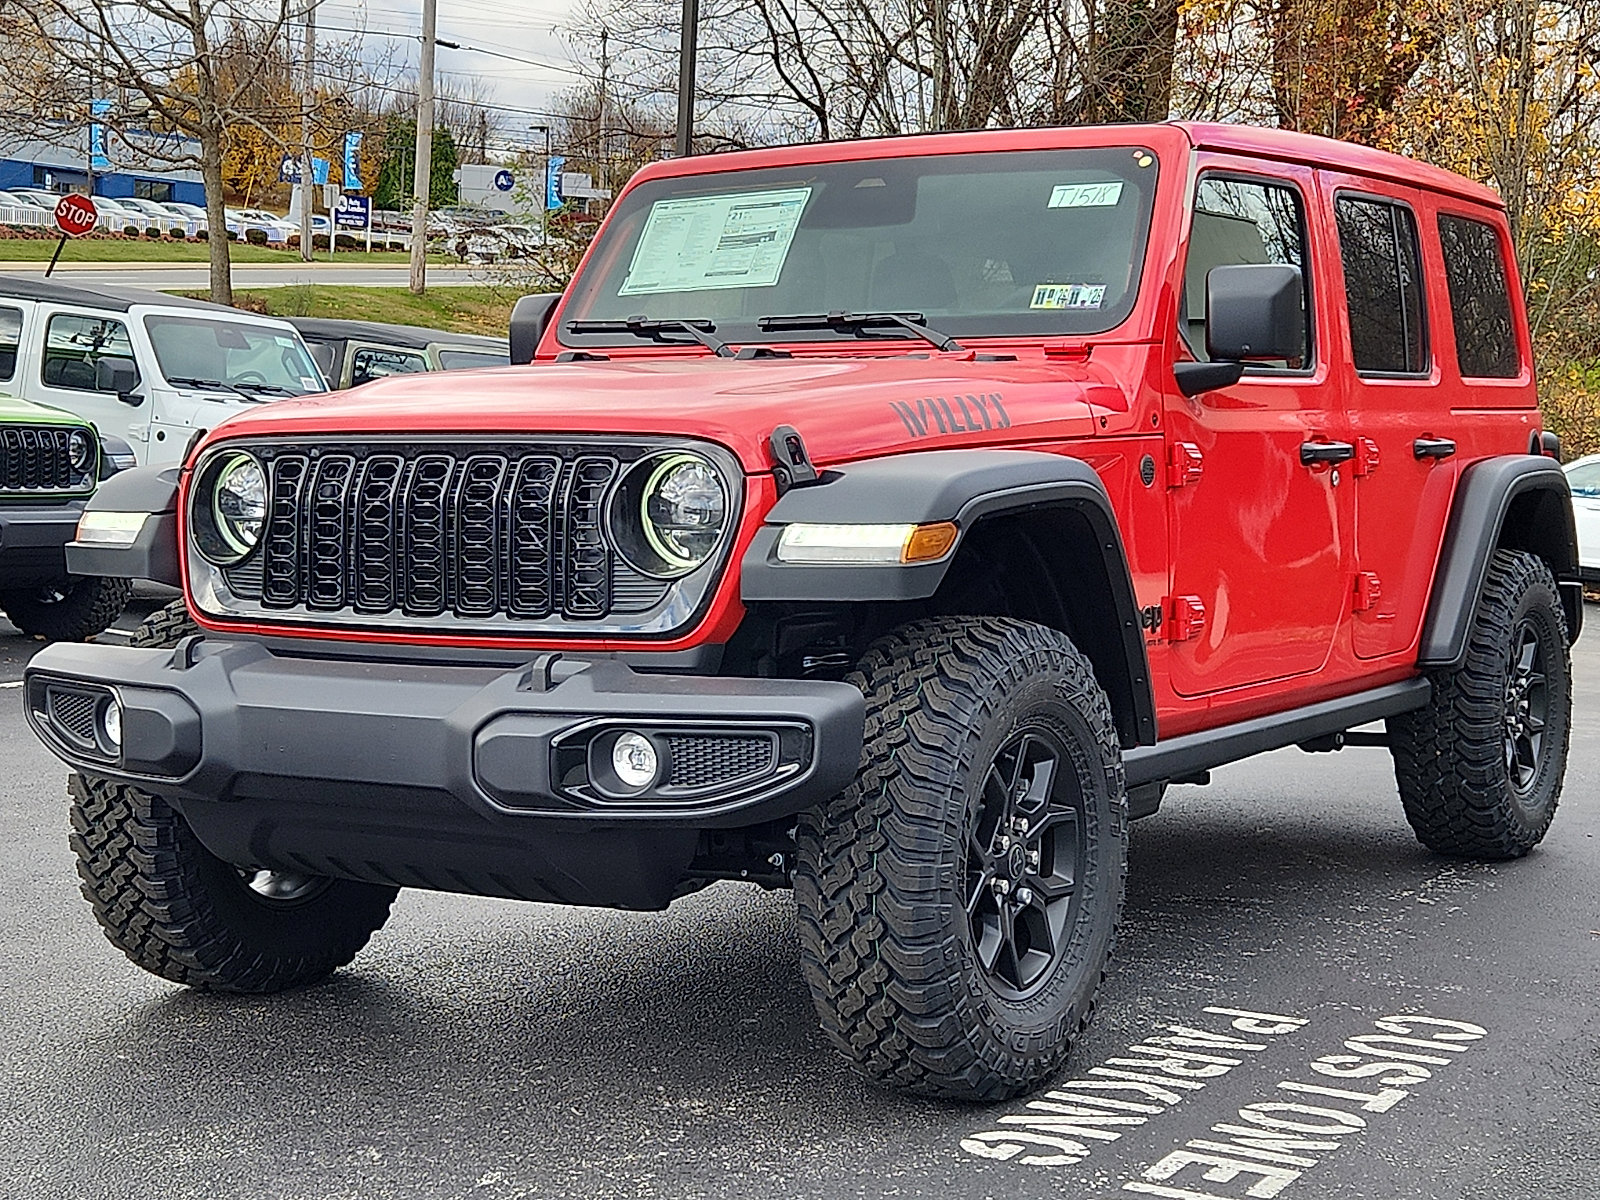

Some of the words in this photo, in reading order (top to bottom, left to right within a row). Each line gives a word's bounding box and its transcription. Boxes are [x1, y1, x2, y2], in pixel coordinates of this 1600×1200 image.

[57, 200, 95, 226] STOP
[889, 393, 1011, 437] WILLYS
[959, 1006, 1310, 1168] PARKING
[1122, 1014, 1488, 1200] CUSTOME
